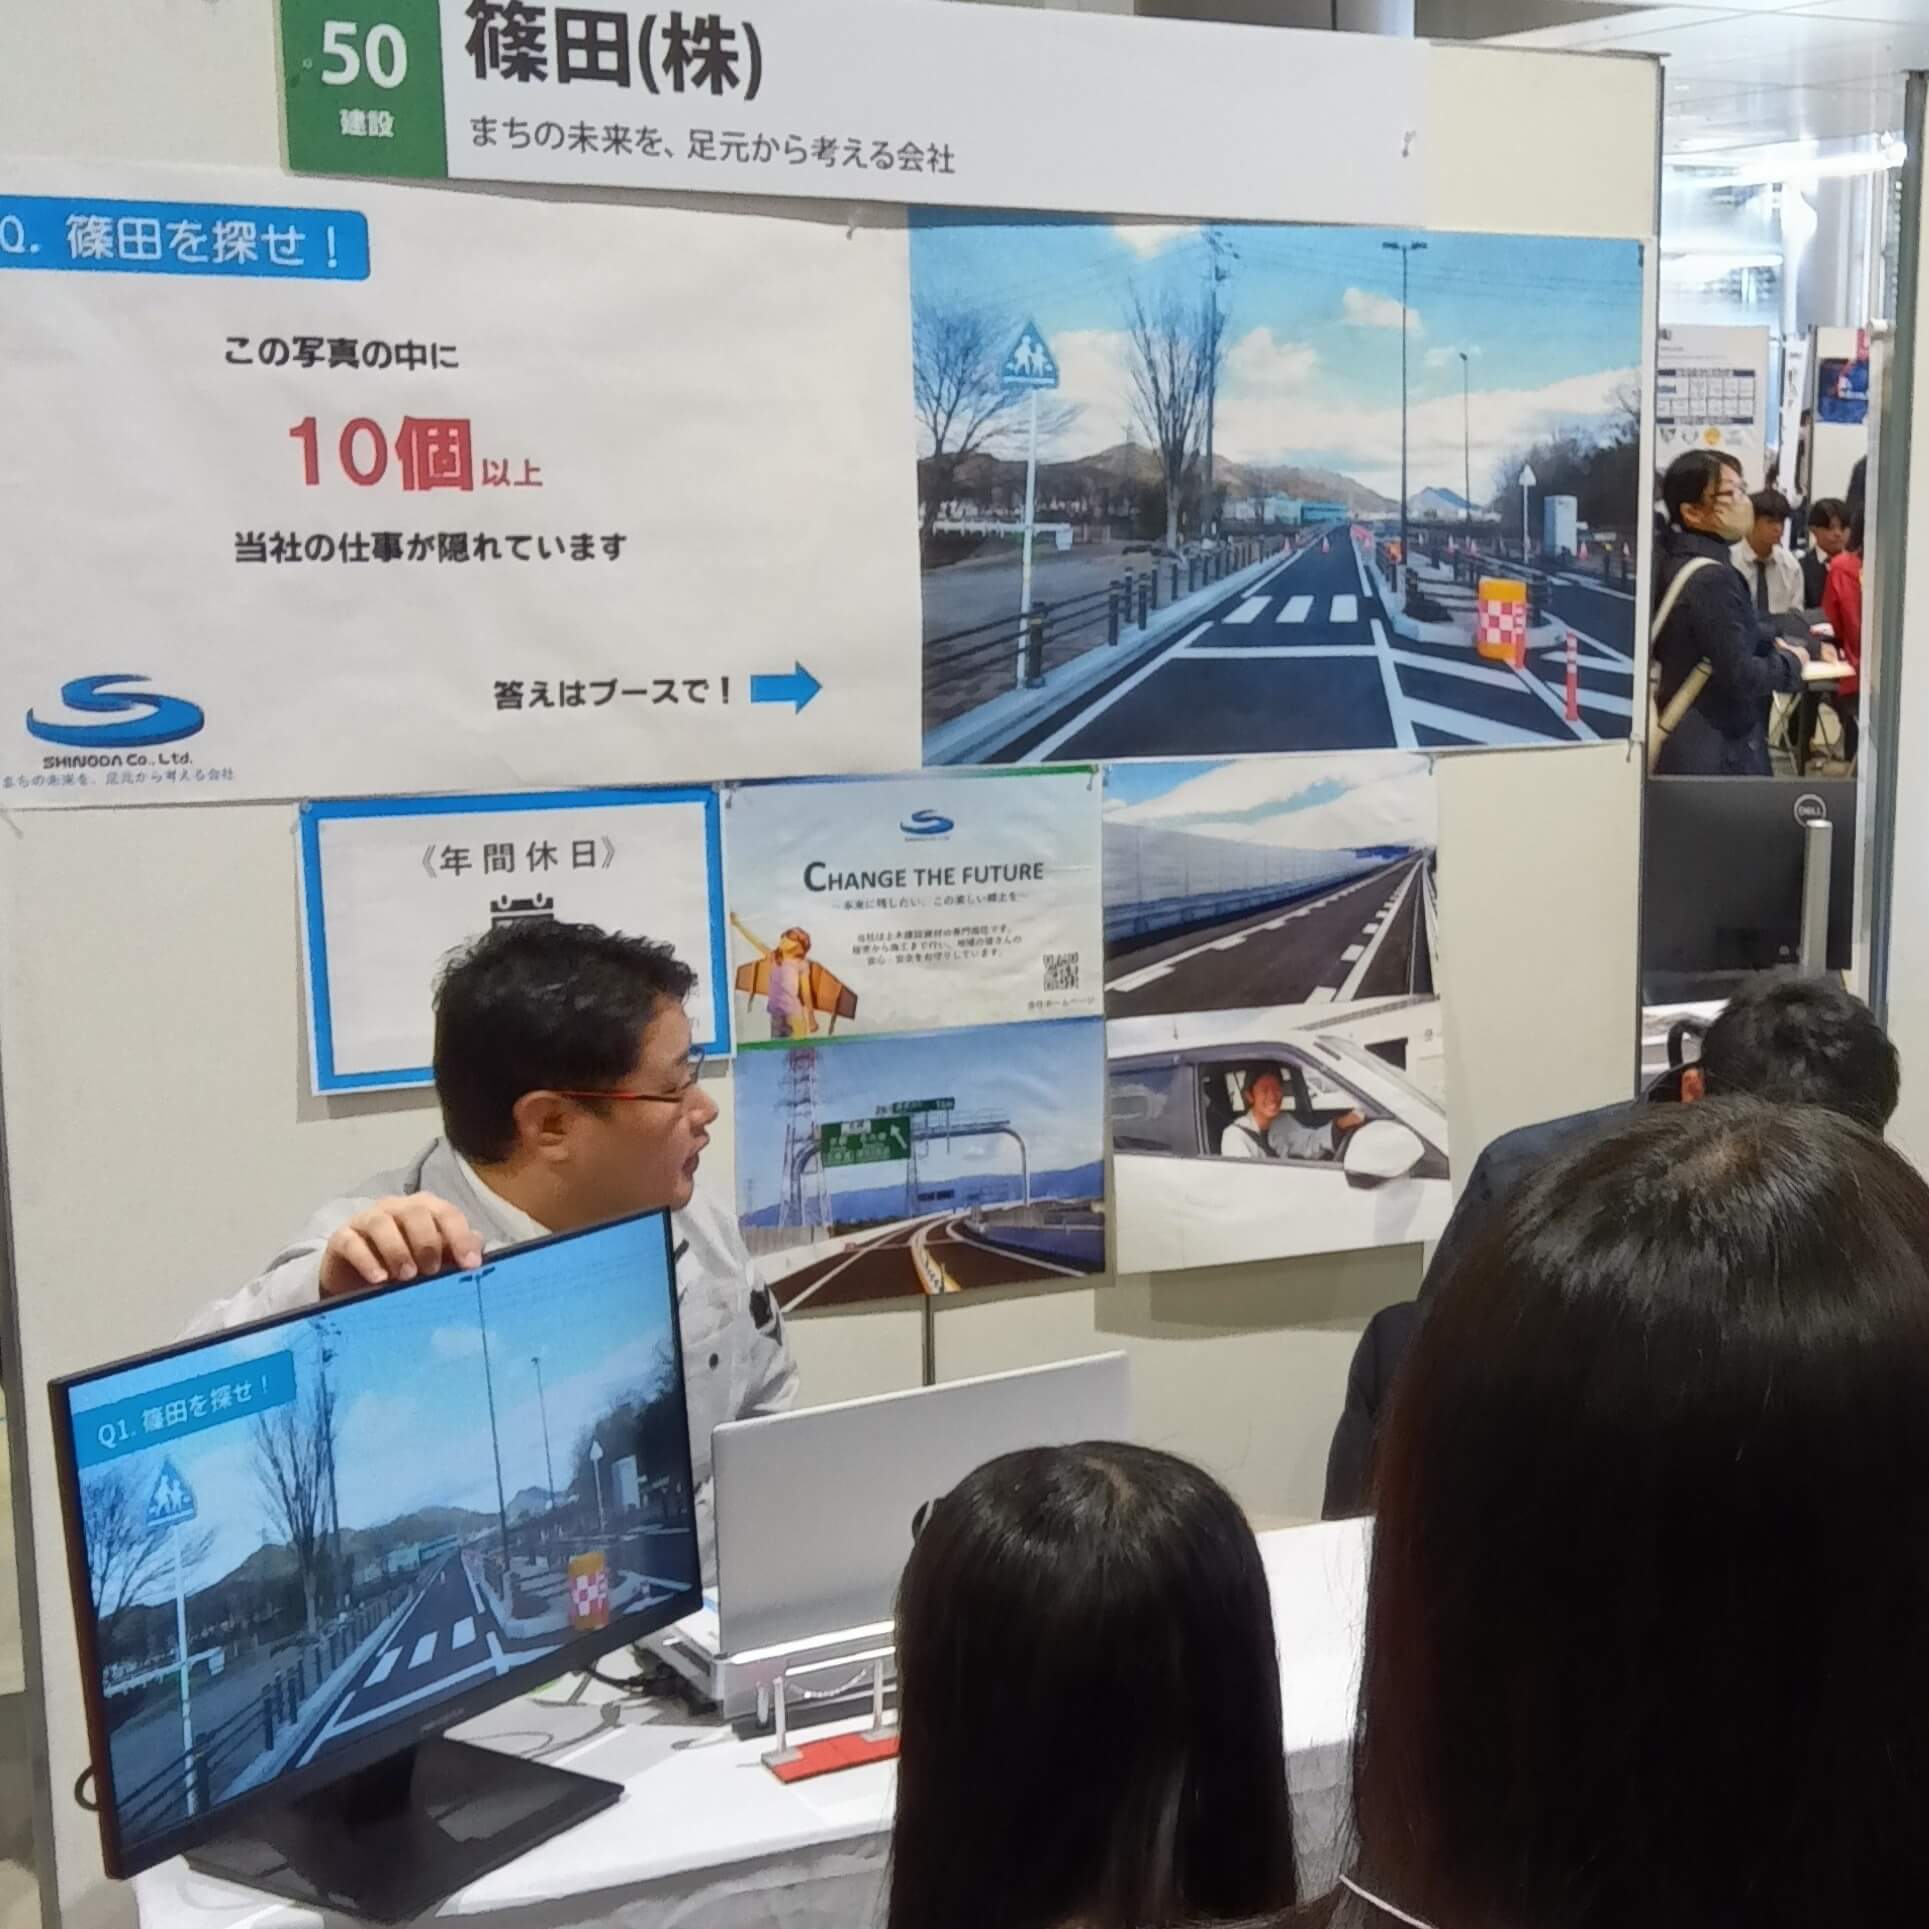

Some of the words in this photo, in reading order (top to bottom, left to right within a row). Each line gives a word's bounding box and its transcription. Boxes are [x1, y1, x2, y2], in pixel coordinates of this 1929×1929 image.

[320, 21, 407, 89] 50
[465, 0, 762, 101] 篠田(株)
[339, 108, 395, 138] 建設
[470, 115, 956, 175] まちの未来を、足元から考える会社
[66, 213, 338, 267] 篠田を探せ！
[224, 335, 459, 371] この写真の中に
[234, 530, 627, 564] 当社の仕事が隠れています
[493, 675, 732, 710] 答えはブースで！
[913, 867, 956, 887] THE
[962, 862, 1045, 885] FUTURE
[97, 1418, 137, 1449] Q1.
[142, 1374, 268, 1433] 篠田を探せ！
